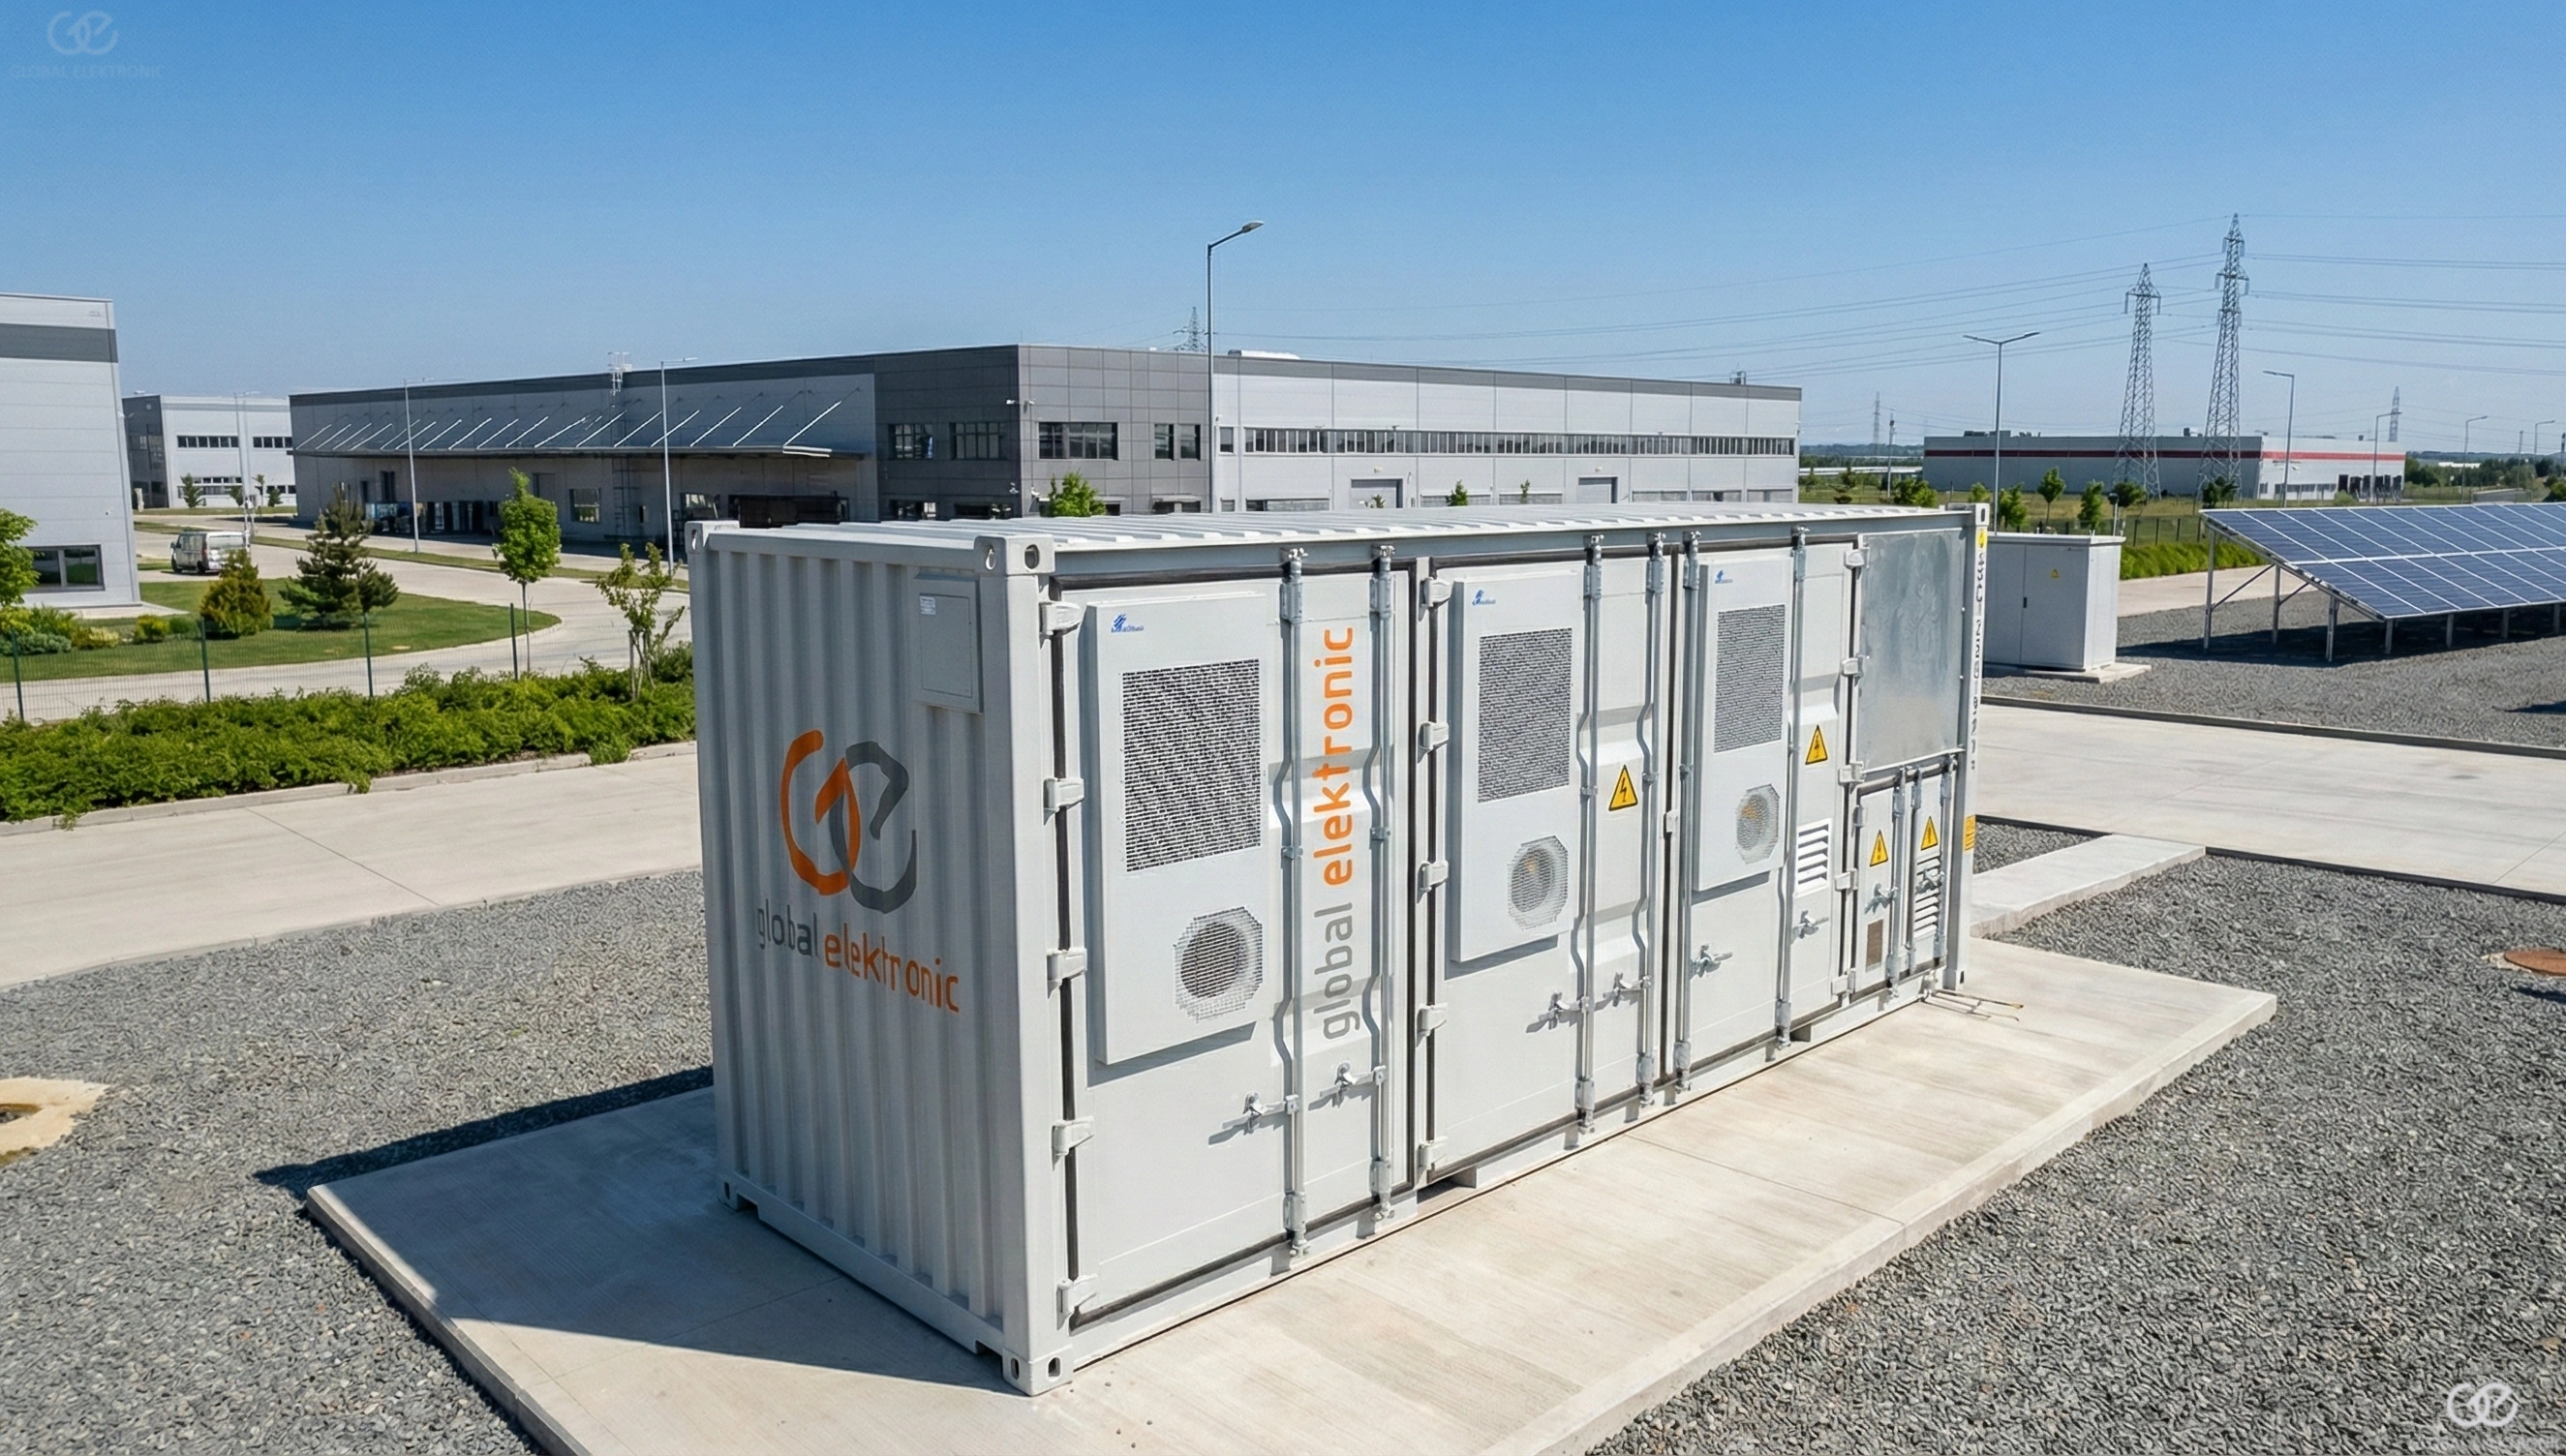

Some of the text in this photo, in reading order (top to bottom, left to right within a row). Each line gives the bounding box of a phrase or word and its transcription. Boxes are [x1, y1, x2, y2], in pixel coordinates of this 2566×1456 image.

[756, 898, 960, 1013] global elektronic
[1313, 627, 1360, 1042] global elektronic
